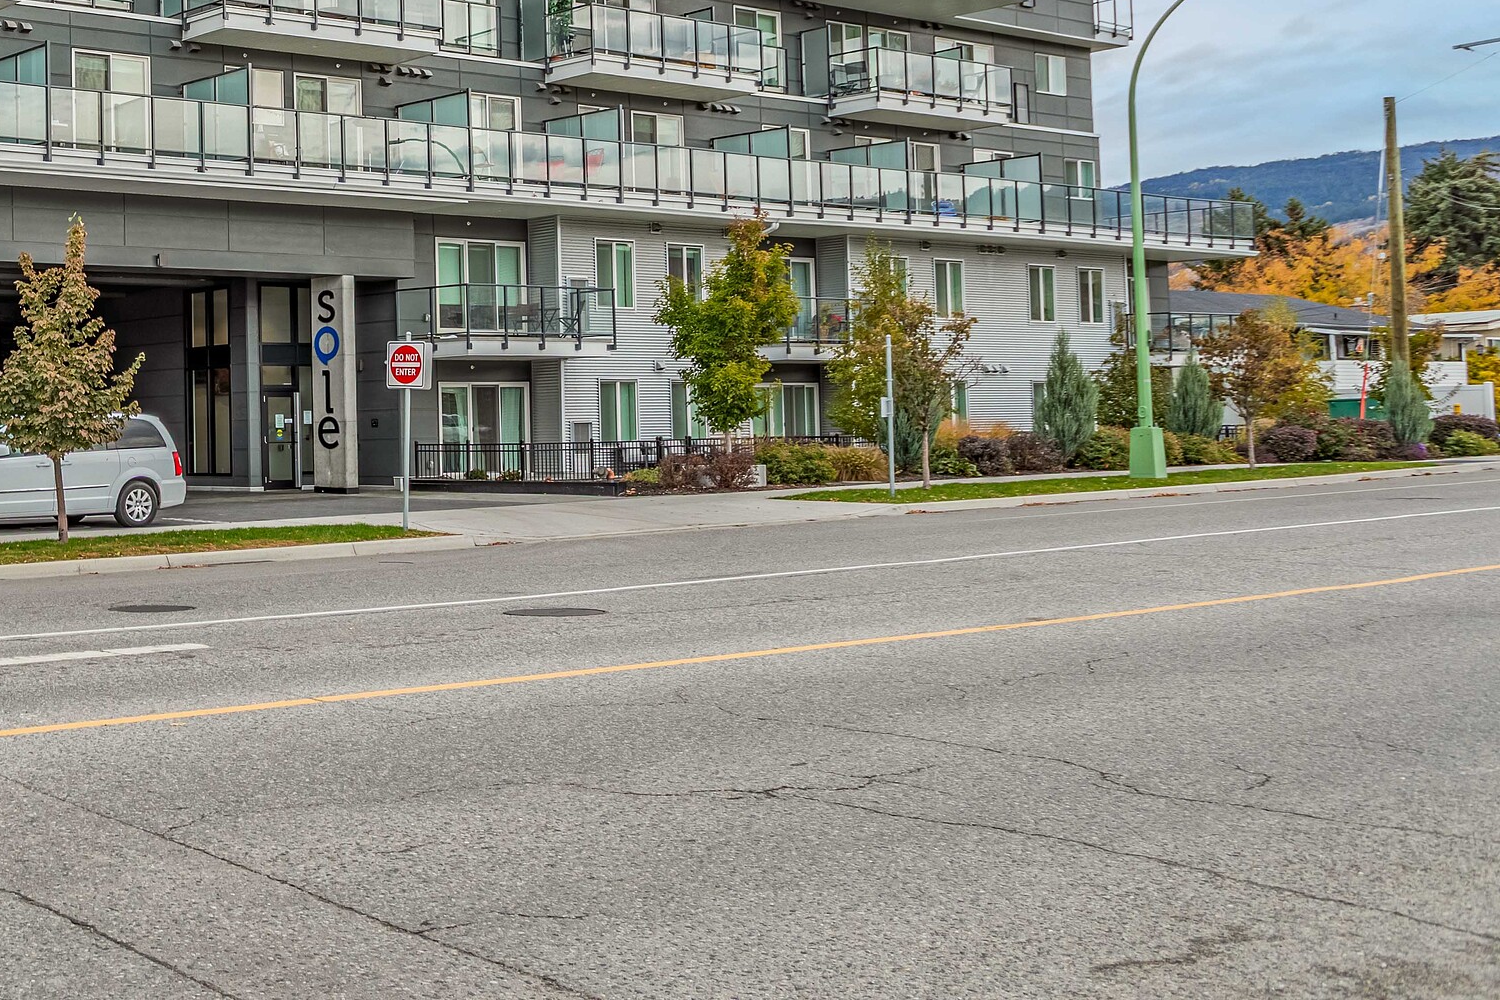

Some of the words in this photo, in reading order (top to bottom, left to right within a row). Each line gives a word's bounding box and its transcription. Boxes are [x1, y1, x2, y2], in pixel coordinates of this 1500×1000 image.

[394, 353, 404, 362] DO
[405, 353, 419, 362] NOT
[395, 368, 417, 376] ENTER
